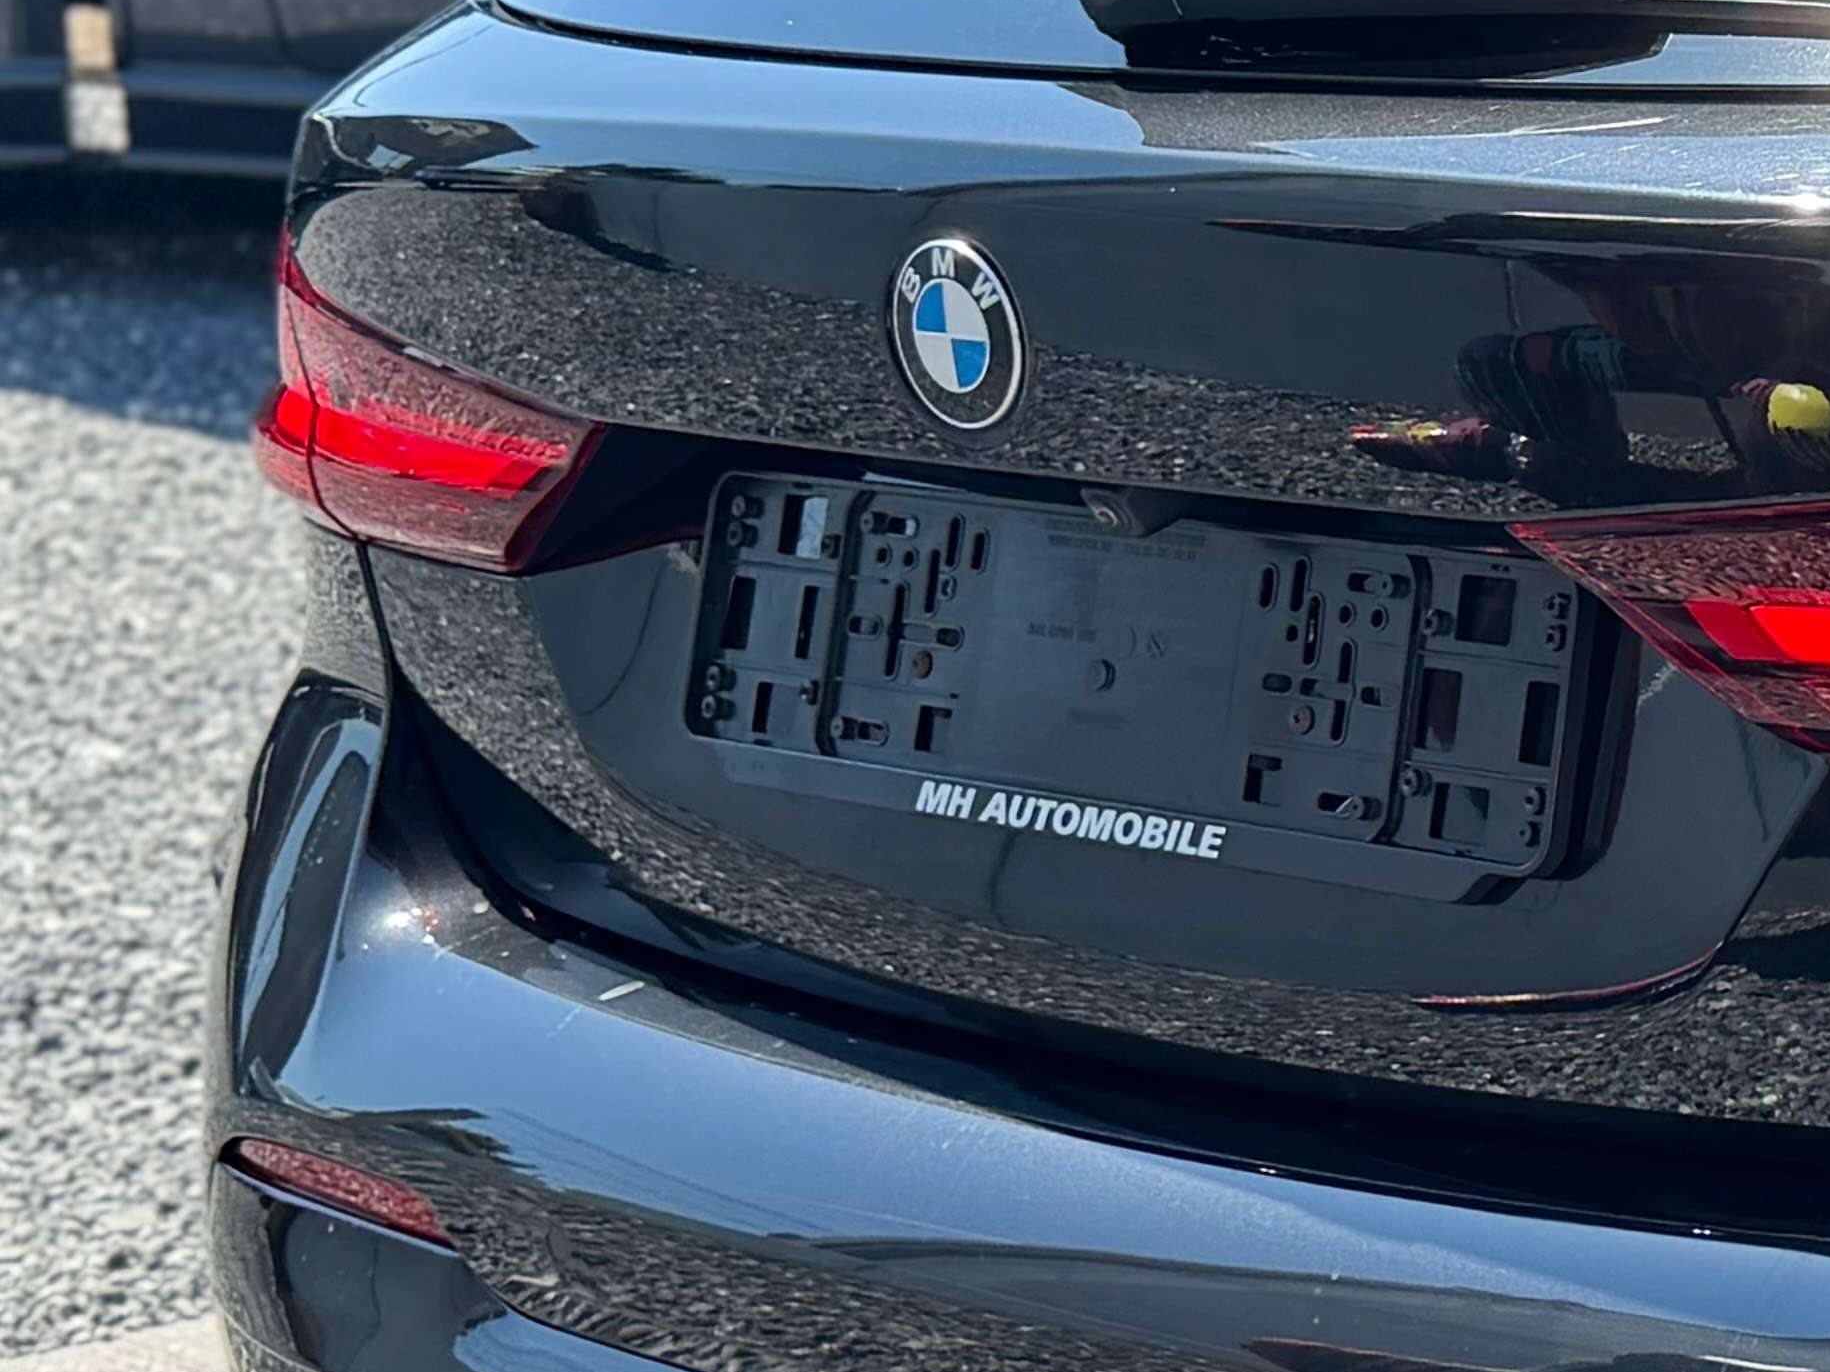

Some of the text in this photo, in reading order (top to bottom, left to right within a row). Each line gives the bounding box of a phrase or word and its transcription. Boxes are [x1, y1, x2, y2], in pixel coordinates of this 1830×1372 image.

[900, 247, 1002, 311] BMW
[915, 780, 1227, 859] MH AUTOMOBILE
